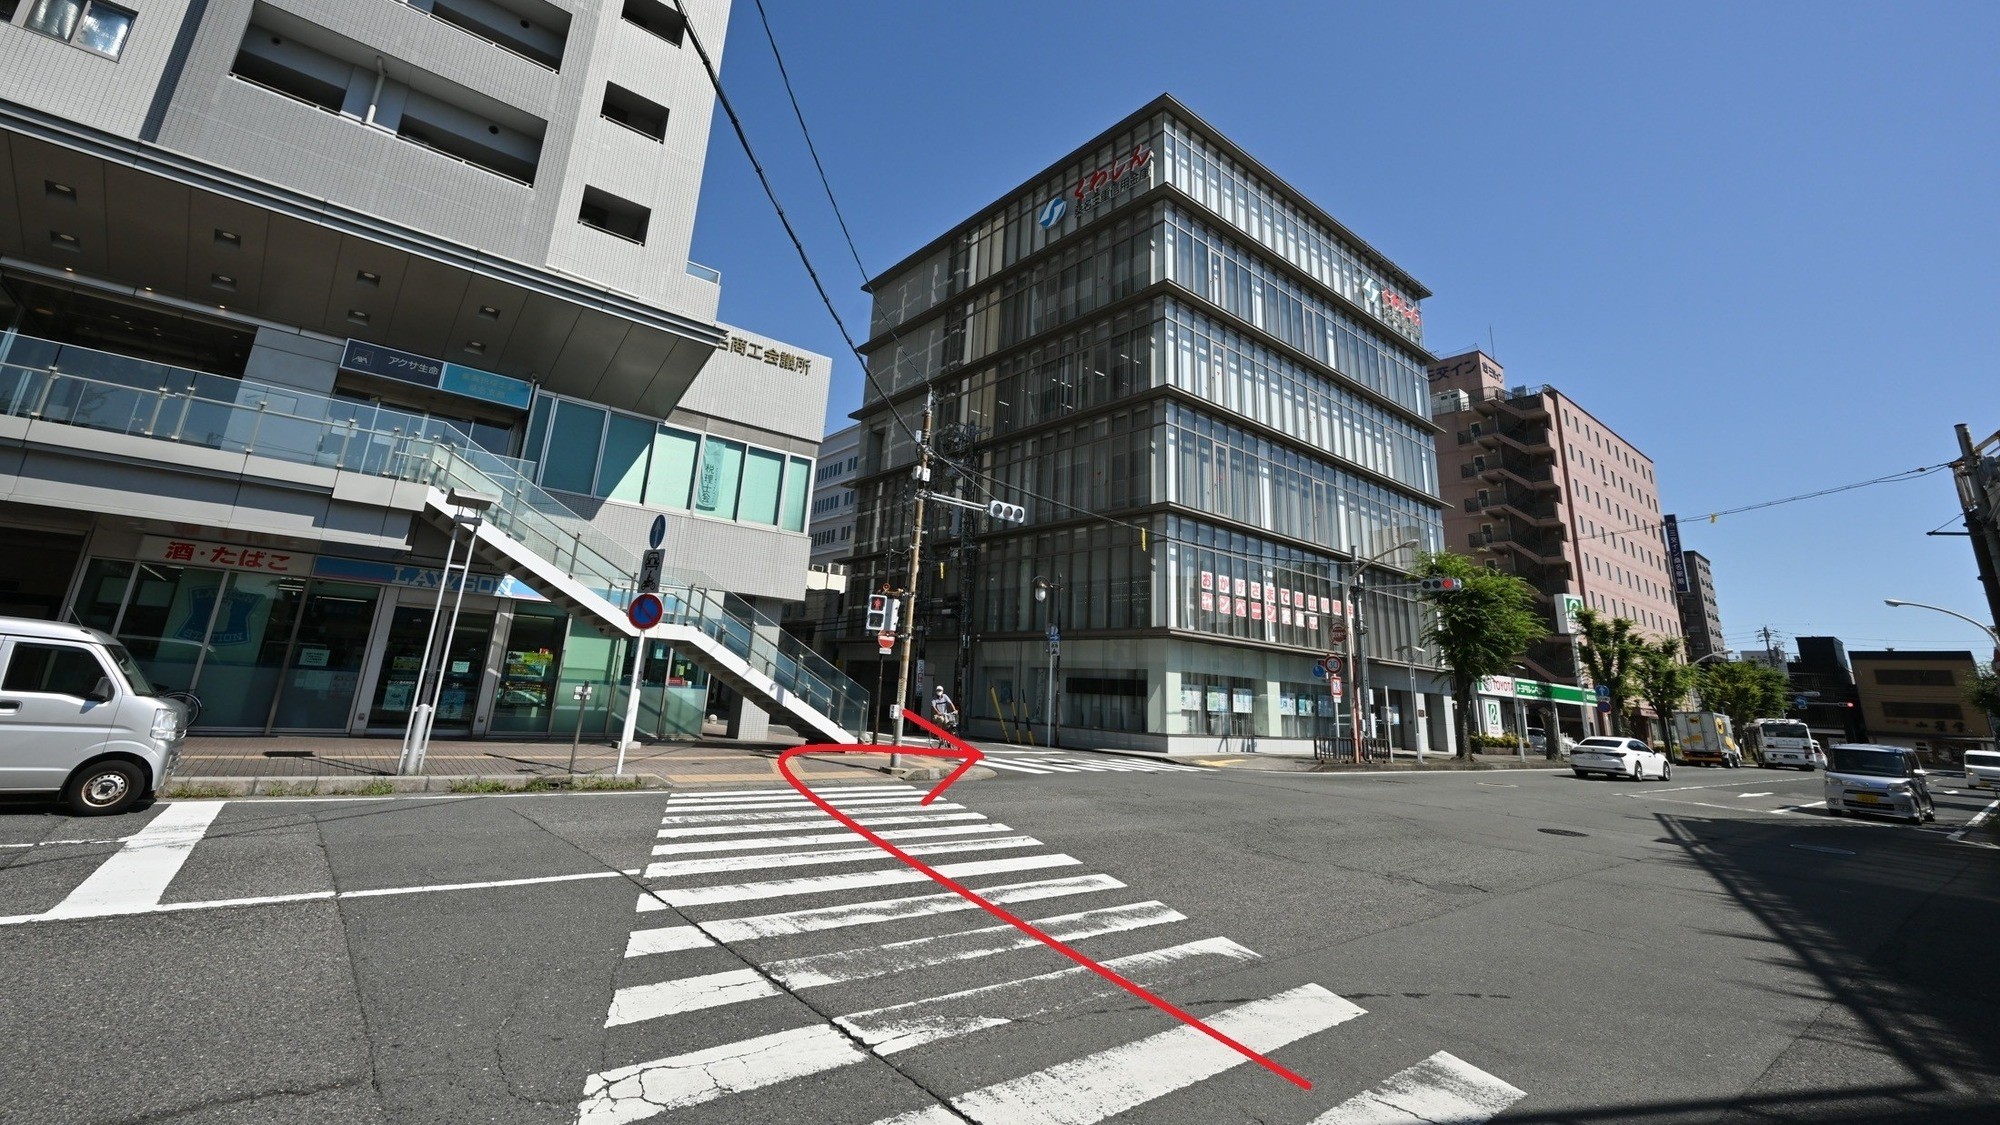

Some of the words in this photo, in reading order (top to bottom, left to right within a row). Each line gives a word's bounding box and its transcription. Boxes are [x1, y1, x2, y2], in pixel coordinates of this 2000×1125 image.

[1074, 144, 1152, 201] くわしん
[388, 355, 440, 376] アクサ生命
[702, 463, 715, 503] 税理士会
[165, 541, 291, 571] 酒・たばこ
[391, 566, 515, 598] LAWSON
[1328, 660, 1338, 669] 30
